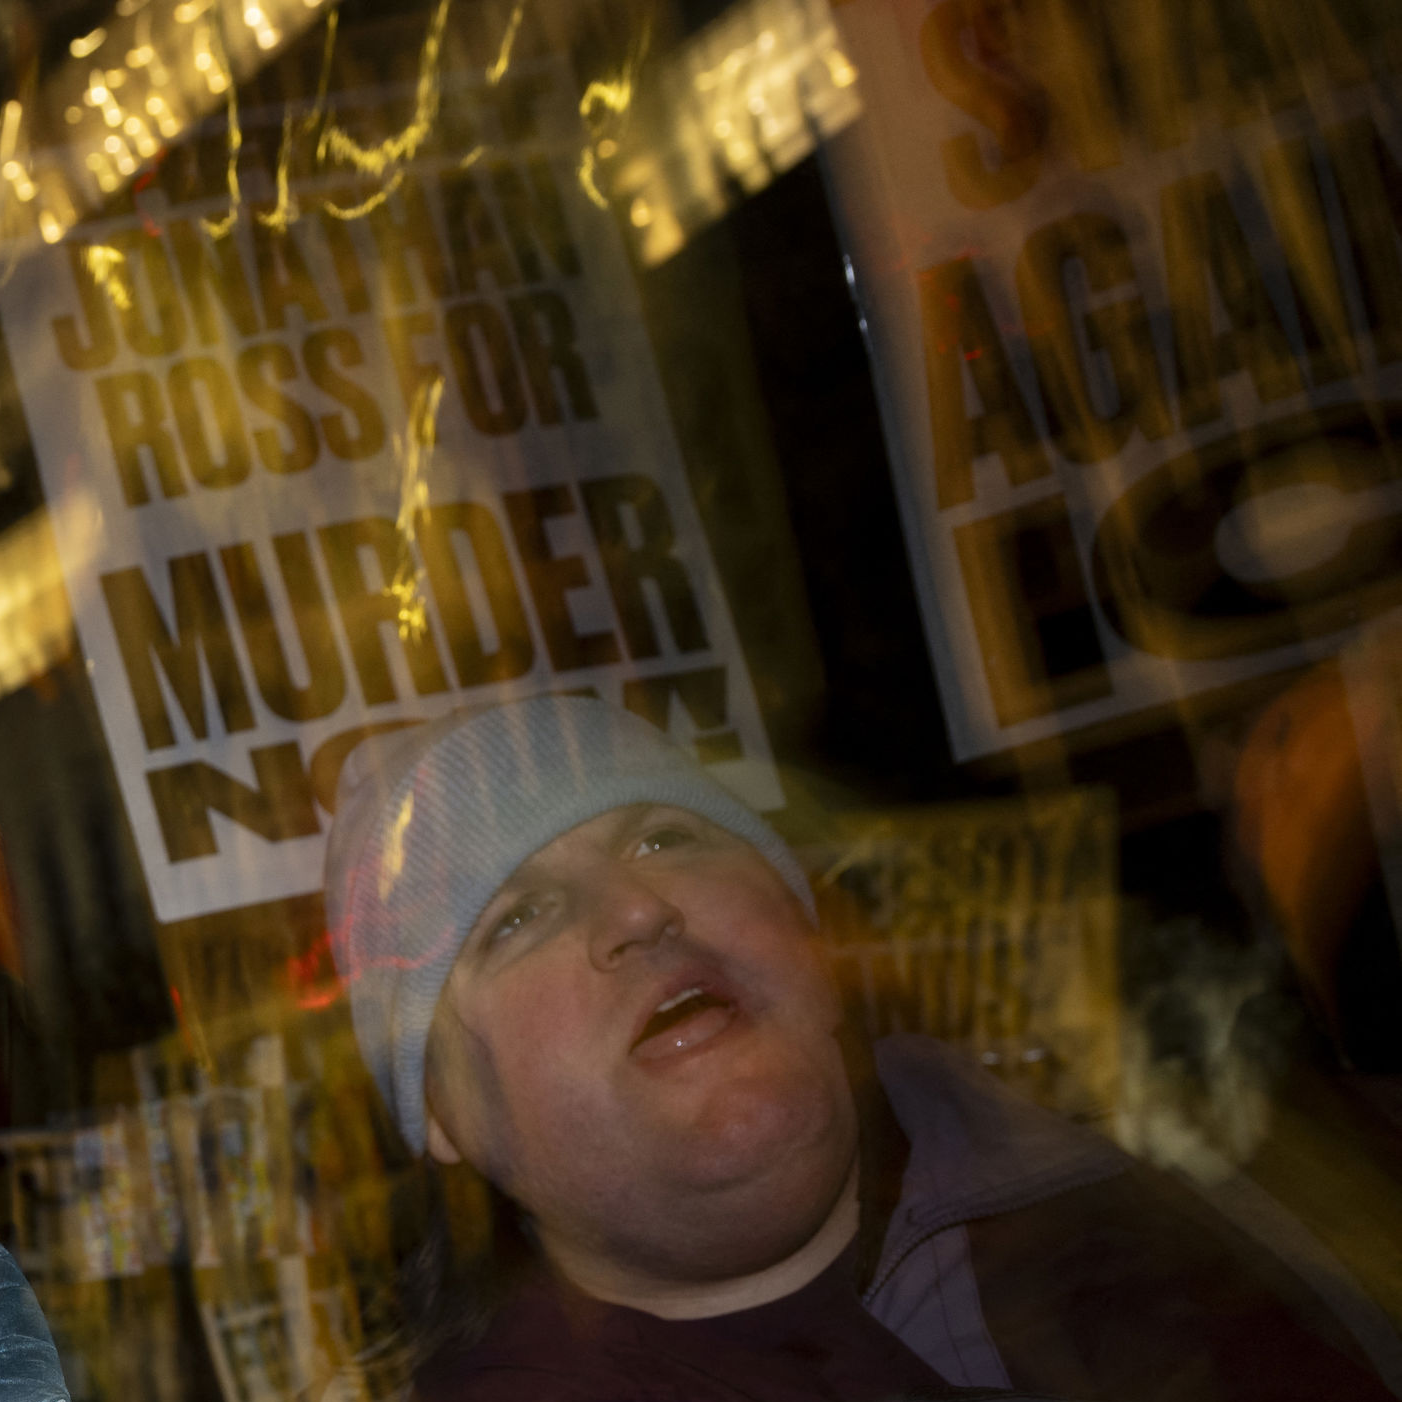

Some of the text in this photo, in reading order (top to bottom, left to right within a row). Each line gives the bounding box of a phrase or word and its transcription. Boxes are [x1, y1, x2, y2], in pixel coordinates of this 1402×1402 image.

[94, 329, 386, 508] ROSS
[99, 472, 713, 752] MURDER
[953, 398, 1402, 730] IC
